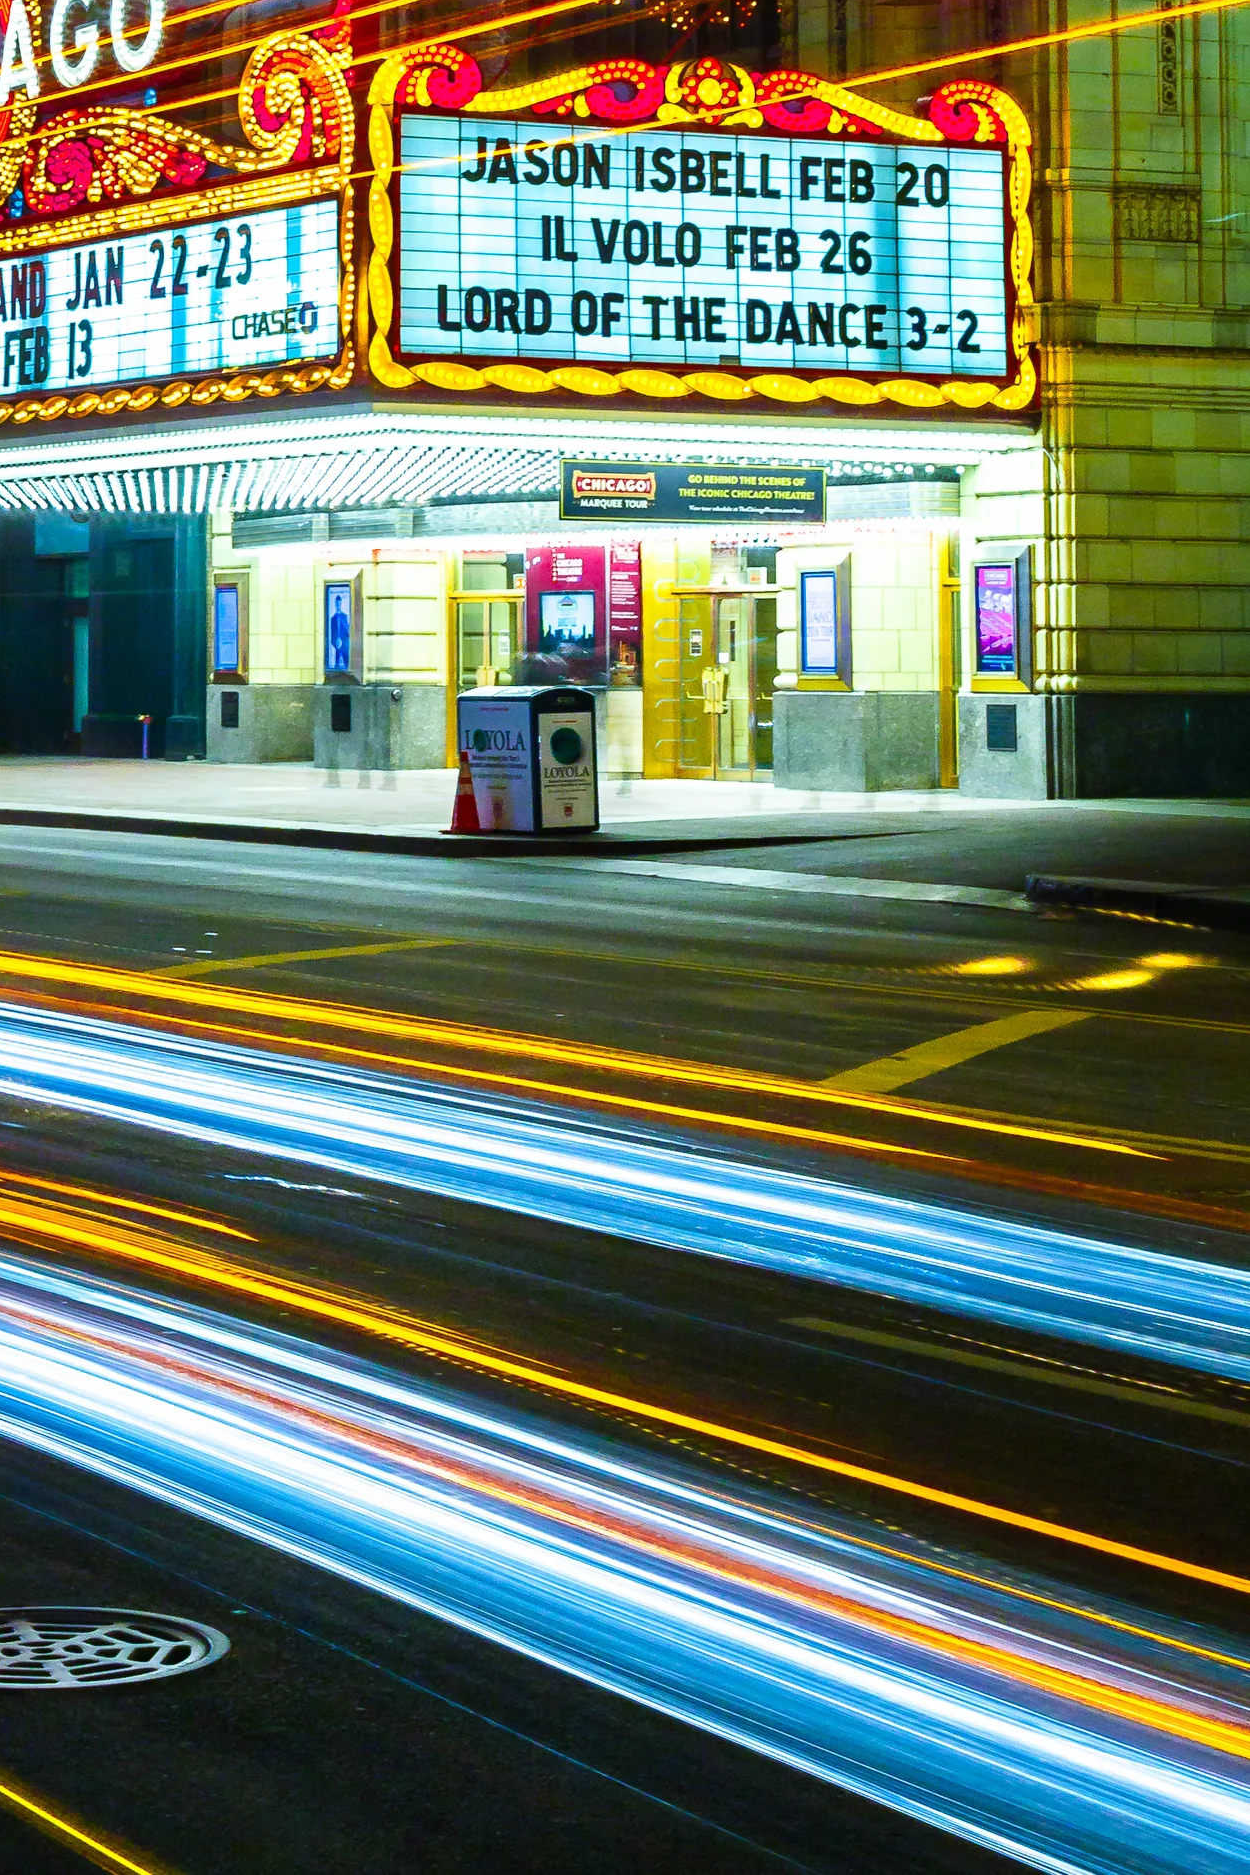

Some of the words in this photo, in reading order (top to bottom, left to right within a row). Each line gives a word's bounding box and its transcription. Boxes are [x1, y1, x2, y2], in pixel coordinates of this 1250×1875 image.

[460, 135, 612, 190] JASON
[634, 145, 781, 200] ISBELL
[800, 155, 876, 204] FEB
[896, 161, 950, 208] 20
[541, 214, 579, 263] IL
[590, 217, 702, 268] VOLO
[725, 224, 801, 272] FEB
[818, 228, 873, 276] 26
[66, 245, 125, 312] JAN
[148, 223, 253, 300] 22-23
[231, 306, 297, 341] CHASE
[437, 283, 553, 336] LORD
[571, 289, 625, 338] OF
[642, 295, 727, 343] THE
[745, 297, 888, 351] DANCE
[906, 306, 981, 354] 3-2
[3, 325, 50, 388] FEB
[68, 318, 93, 380] 13
[581, 478, 647, 492] CHICAGO
[678, 488, 696, 497] THE
[697, 488, 730, 498] ICONIC
[731, 489, 773, 499] CHICAGO
[687, 474, 703, 484] GO
[703, 475, 738, 484] BEHIND
[739, 476, 757, 485] THE
[758, 476, 792, 486] SCENES
[792, 477, 806, 486] OF
[580, 499, 623, 509] MARQUEE
[624, 499, 648, 508] TOUR
[465, 729, 526, 751] LYOLA
[544, 765, 590, 779] LOYOLA
